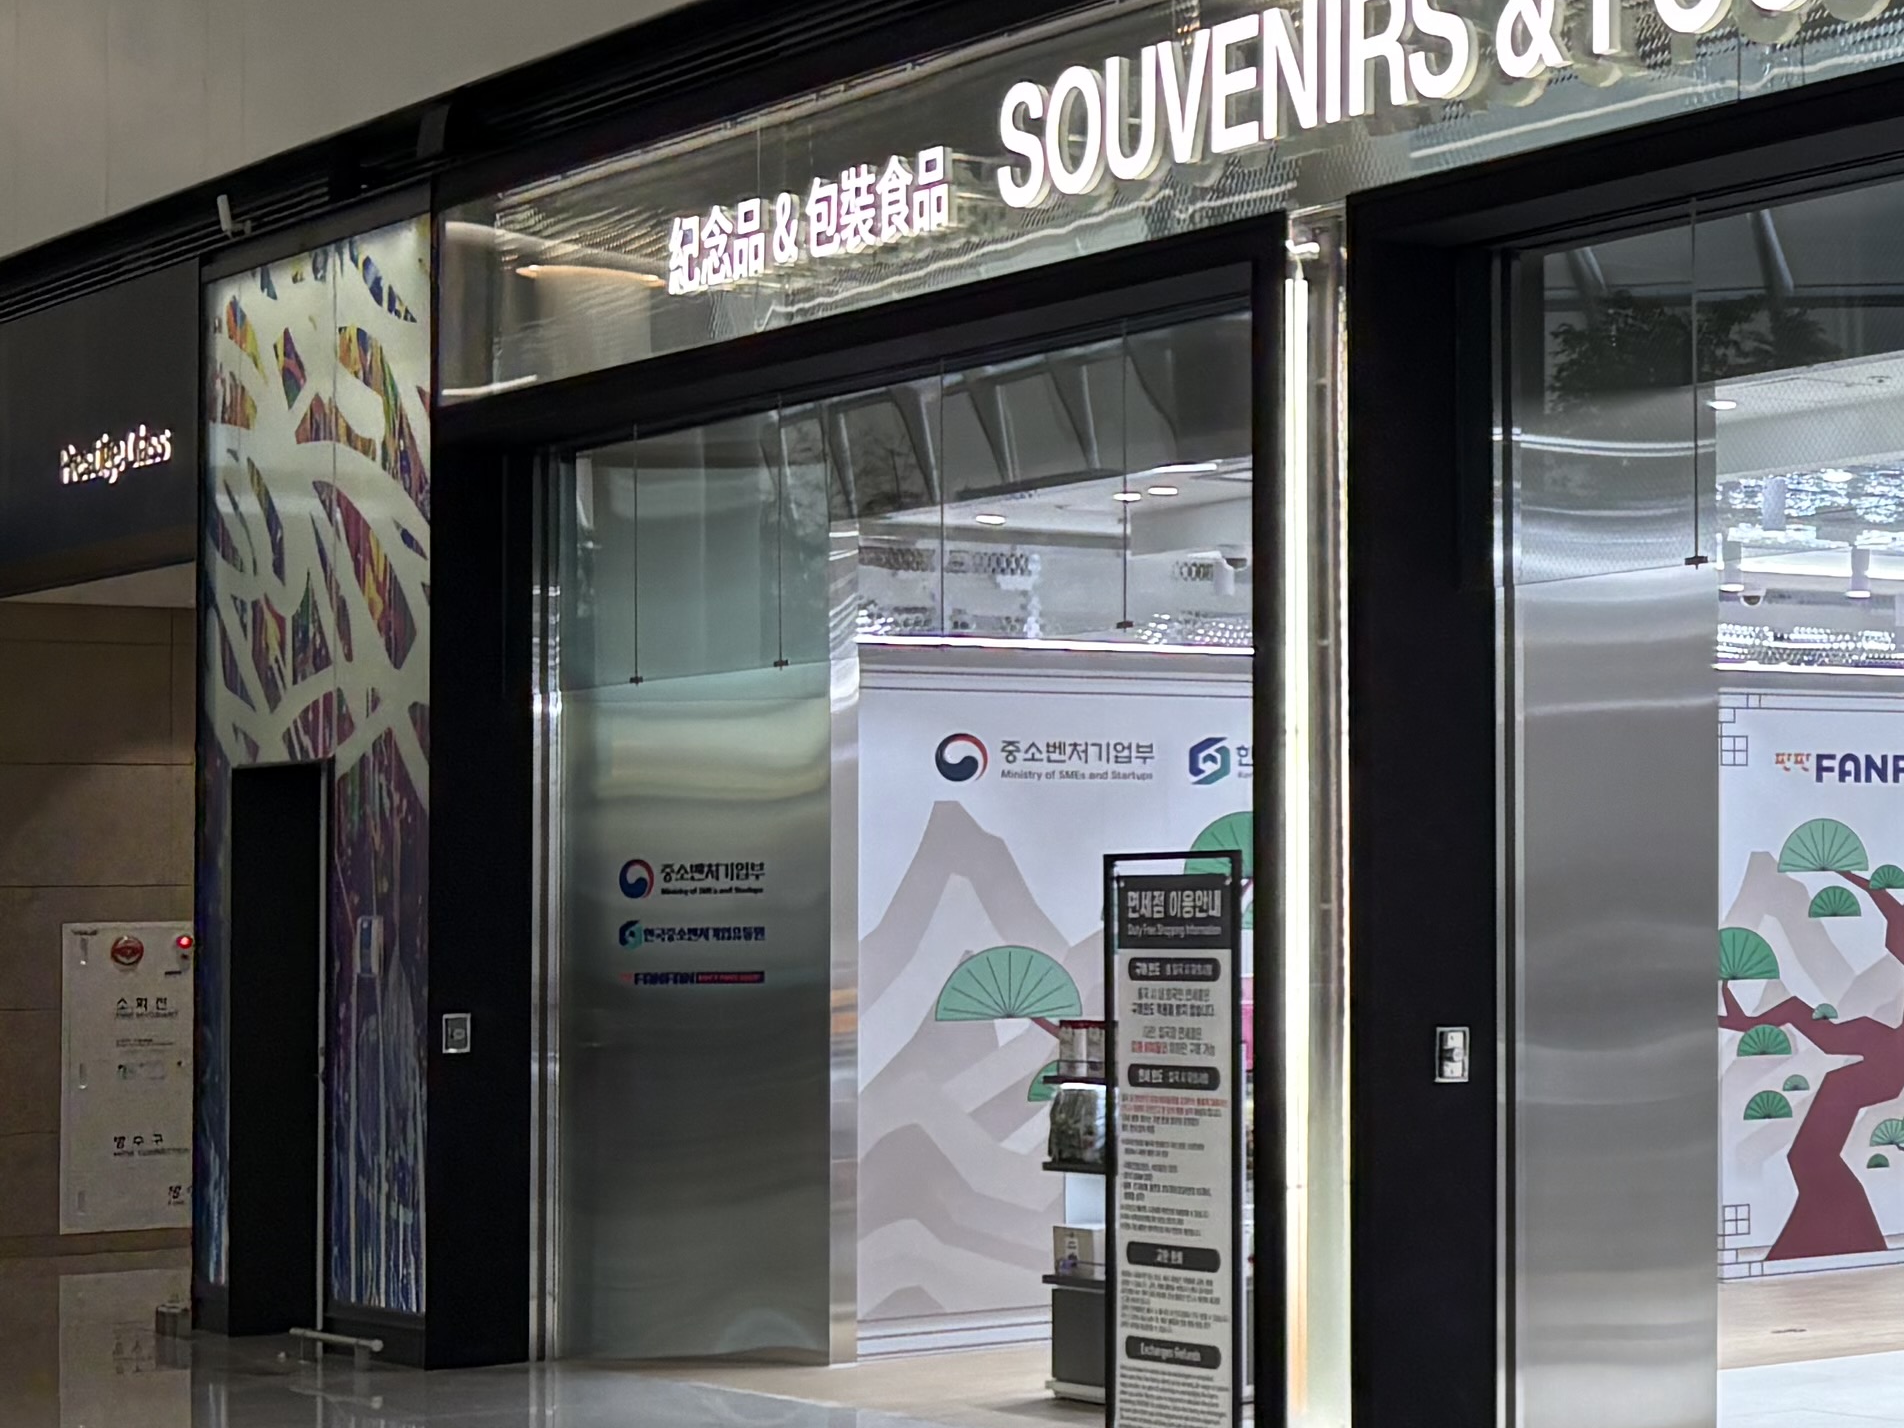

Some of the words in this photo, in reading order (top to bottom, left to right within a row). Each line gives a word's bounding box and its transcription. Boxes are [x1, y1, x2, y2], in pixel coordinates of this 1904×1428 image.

[669, 198, 766, 295] 紀念品
[773, 192, 799, 264] &
[805, 146, 950, 258] 包裝食品
[1000, 739, 1156, 765] 중소벤처기업부
[1001, 769, 1043, 781] Ministry
[1045, 769, 1056, 779] of
[1089, 769, 1109, 780] and
